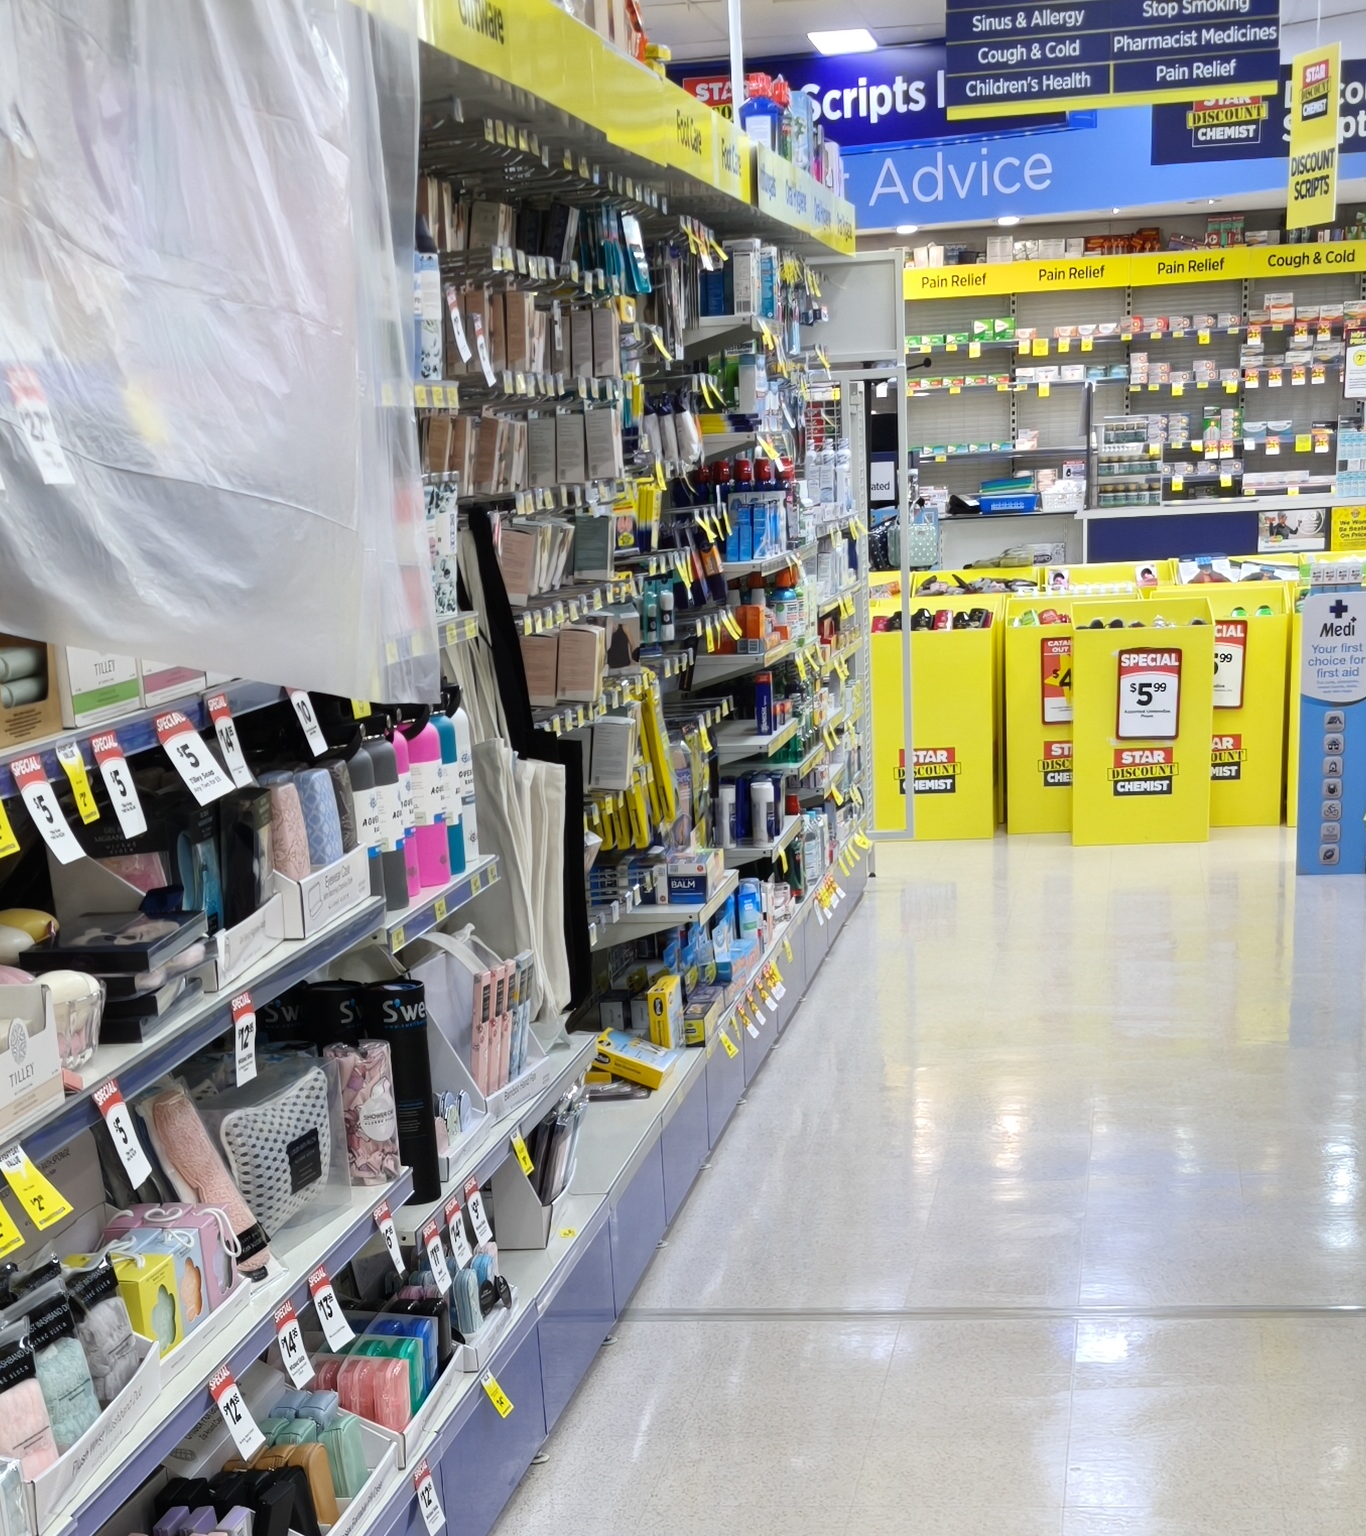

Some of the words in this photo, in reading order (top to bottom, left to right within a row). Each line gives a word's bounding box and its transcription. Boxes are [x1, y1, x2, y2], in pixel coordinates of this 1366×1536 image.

[1143, 0, 1178, 18] Stop
[972, 15, 1012, 32] Sinus
[1016, 13, 1027, 28] &
[1031, 9, 1085, 31] Allergy
[1114, 33, 1197, 52] Pharmacist
[1201, 25, 1277, 45] Medicines
[978, 44, 1027, 65] Cough
[1030, 43, 1041, 59] &
[1045, 40, 1080, 58] Cold
[1156, 64, 1189, 82] Pain
[1193, 59, 1237, 78] Relief
[1305, 63, 1326, 83] STAR
[966, 77, 1038, 97] Children's
[1043, 71, 1091, 91] Health
[1302, 79, 1330, 101] DISCOUNT
[801, 77, 925, 123] Scripts
[1302, 98, 1327, 117] CHEMIST
[1193, 106, 1264, 125] DISCOUNT
[1197, 125, 1256, 141] CHEMIST
[1291, 148, 1335, 177] DISCOUNT
[869, 147, 1053, 206] Advice
[1294, 175, 1330, 201] SCRIPTS
[1158, 261, 1184, 275] Pain
[1188, 258, 1224, 273] Relief
[1267, 252, 1310, 268] Cough
[1313, 252, 1321, 264] &
[1326, 250, 1355, 264] Cold
[922, 275, 947, 289] Pain
[952, 273, 986, 287] Relief
[1039, 268, 1065, 281] Pain
[1069, 265, 1105, 279] Relief
[1320, 621, 1355, 637] Medi
[1312, 644, 1337, 654] Your
[1341, 643, 1363, 653] first
[94, 660, 115, 677] TILLEY
[1121, 654, 1179, 667] SPECIAL
[1308, 657, 1346, 666] choice
[1350, 655, 1366, 664] for
[1317, 668, 1338, 678] first
[1342, 667, 1359, 677] aid
[208, 697, 227, 712] SPECIAL
[157, 712, 187, 731] SPECIAL
[92, 735, 117, 753] SPECIAL
[177, 743, 200, 768] $5
[1122, 751, 1165, 764] STAR
[11, 758, 41, 776] SPECIAL
[1112, 765, 1175, 778] DISCOUNT
[111, 770, 127, 797] $5
[1117, 781, 1169, 792] CHEMIST
[35, 795, 54, 824] $5
[232, 992, 251, 1011] SPECIAL
[9, 1063, 35, 1088] TILLEY
[93, 1079, 118, 1108] SPECIAL
[114, 1116, 129, 1143] $5
[6, 1156, 22, 1168] VALUE
[308, 1266, 326, 1287] SPECIAL
[274, 1301, 293, 1322] SPECIAL
[209, 1367, 230, 1391] SPECIAL
[414, 1461, 429, 1486] SPECIAL
